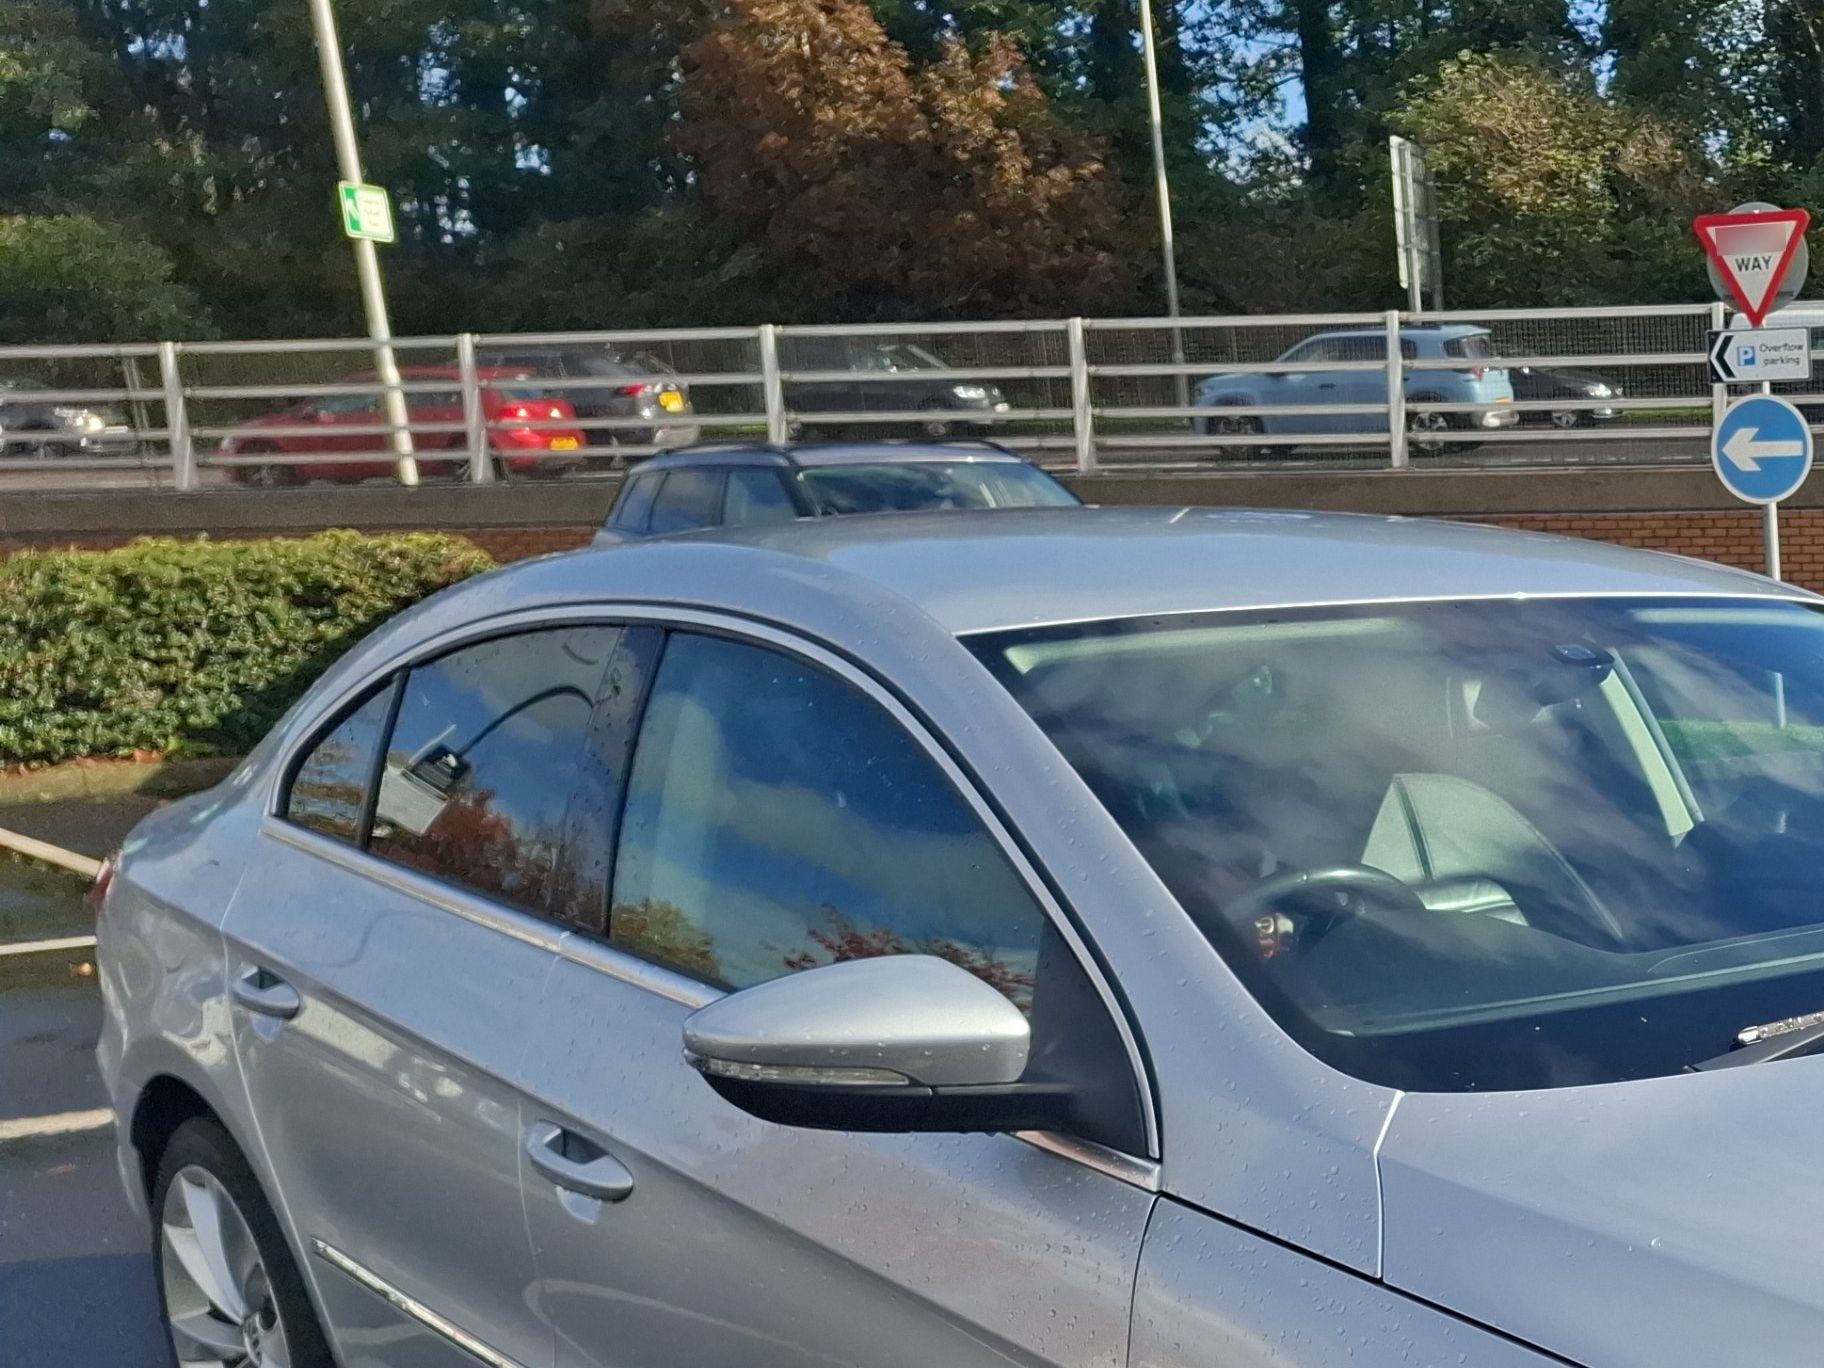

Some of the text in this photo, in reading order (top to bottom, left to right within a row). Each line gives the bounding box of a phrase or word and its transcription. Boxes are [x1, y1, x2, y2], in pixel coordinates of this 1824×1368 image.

[1735, 256, 1772, 272] WAY
[1759, 343, 1804, 353] Overflow
[1739, 347, 1754, 366] P
[1763, 355, 1801, 366] parking
